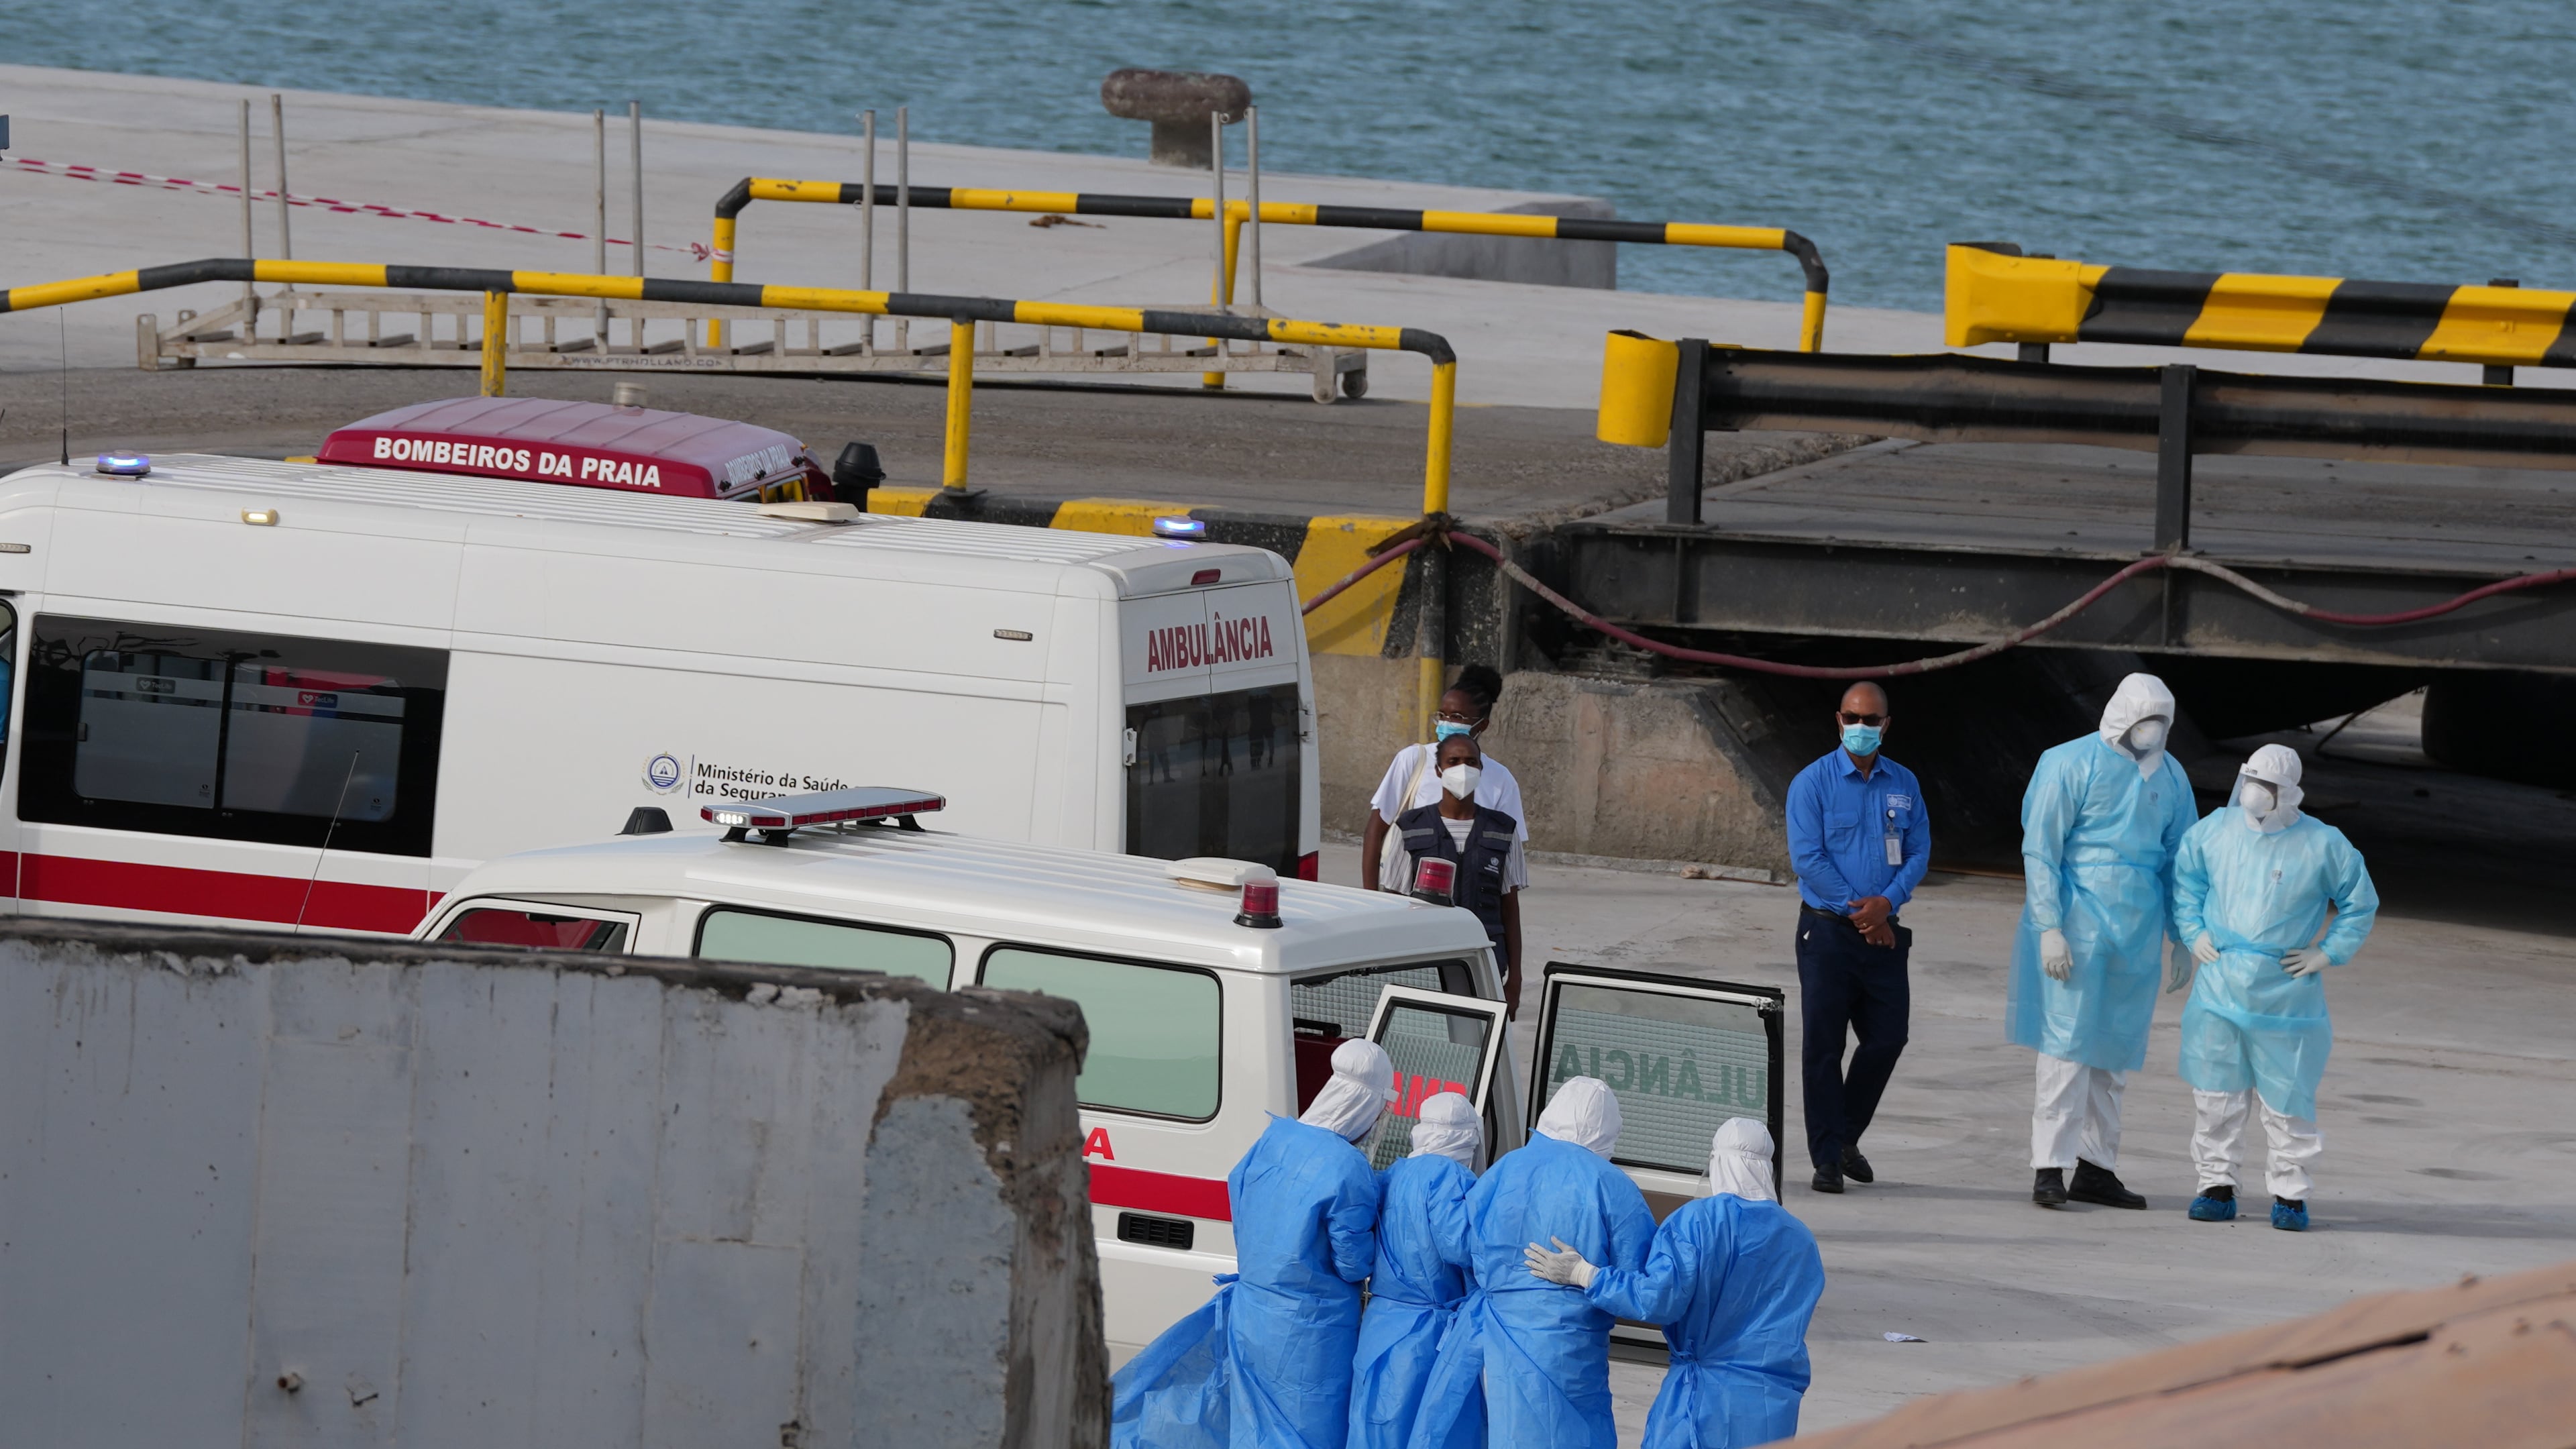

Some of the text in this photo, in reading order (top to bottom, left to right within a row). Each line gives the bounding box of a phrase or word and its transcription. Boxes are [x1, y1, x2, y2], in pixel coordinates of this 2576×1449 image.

[374, 437, 661, 488] BOMBEIROS DA PRAIA
[1148, 611, 1273, 673] AMBULÂNCIA
[695, 780, 714, 795] da
[697, 763, 848, 792] Ministério da Saúde
